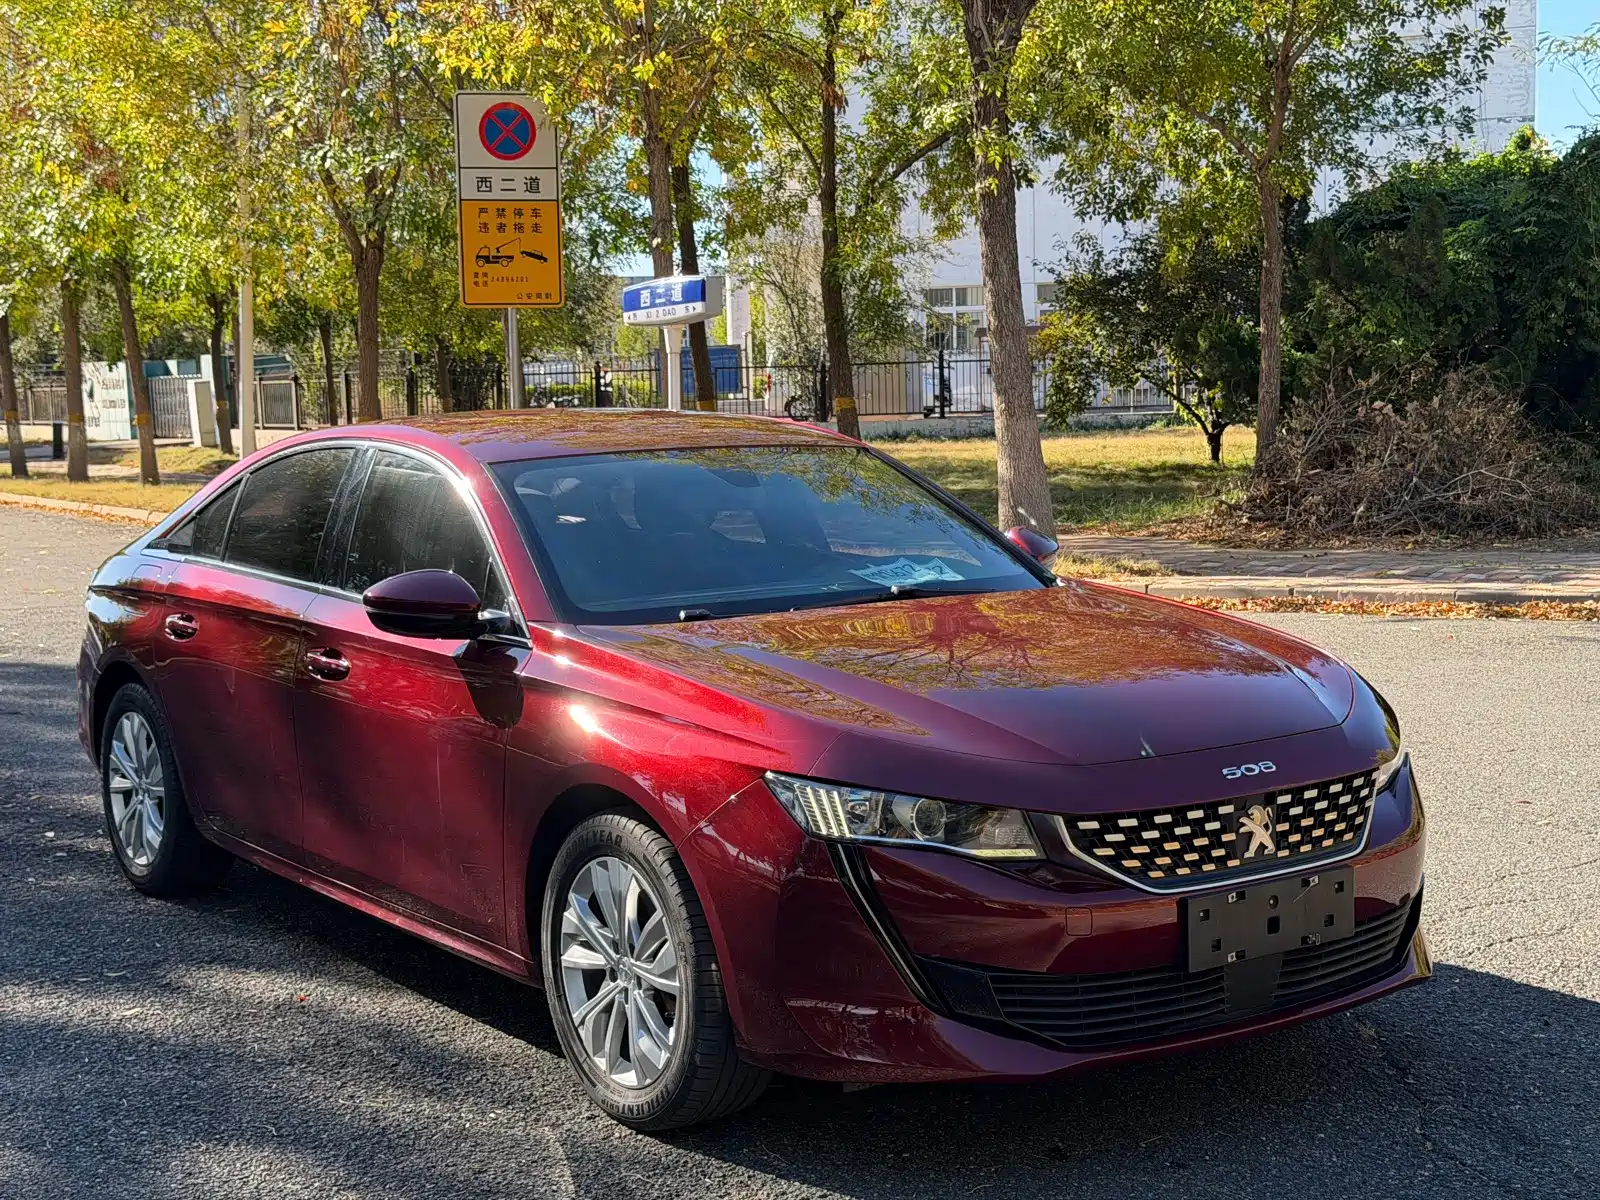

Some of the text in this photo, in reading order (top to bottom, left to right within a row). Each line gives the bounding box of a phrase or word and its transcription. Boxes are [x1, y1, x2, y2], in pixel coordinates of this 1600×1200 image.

[475, 176, 541, 194] 西二道
[478, 207, 542, 219] 严禁停车
[478, 222, 542, 234] 违者拖走
[640, 283, 682, 308] 西二道
[656, 309, 660, 318] 2
[662, 308, 676, 317] DAO
[1222, 761, 1276, 779] 508
